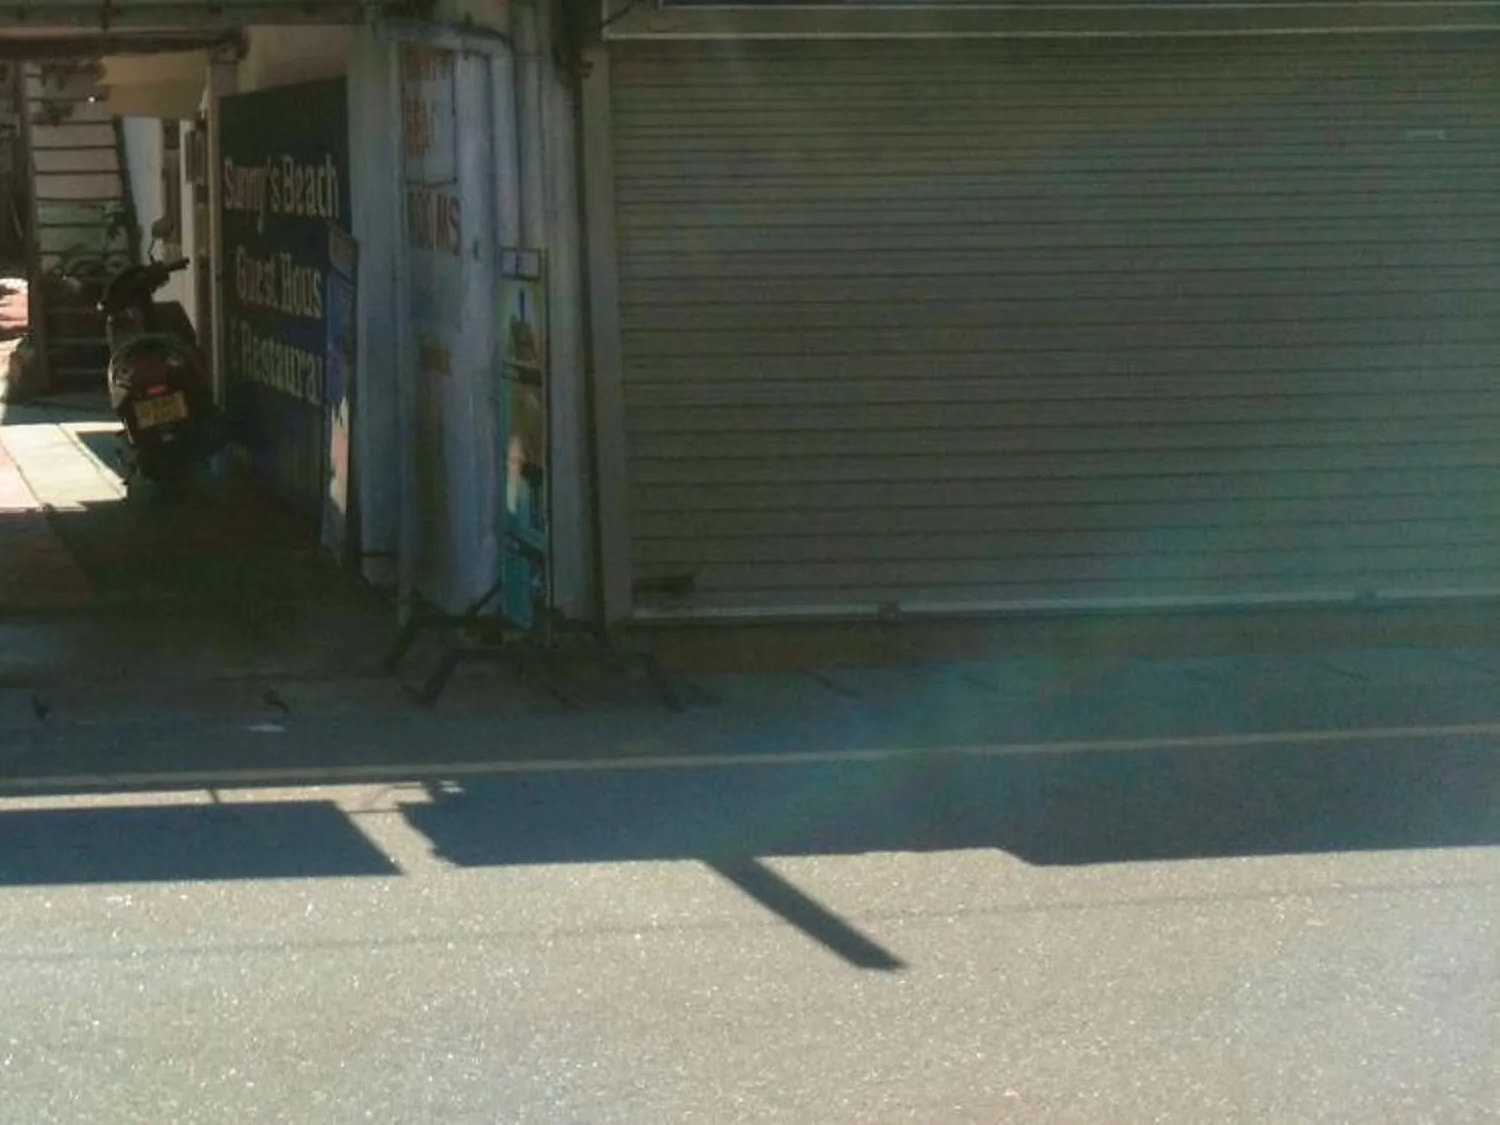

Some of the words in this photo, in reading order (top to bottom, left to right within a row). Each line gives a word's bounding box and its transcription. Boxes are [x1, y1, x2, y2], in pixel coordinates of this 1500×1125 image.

[279, 151, 341, 220] Beach
[235, 243, 279, 311] Guest
[279, 250, 323, 319] Hous
